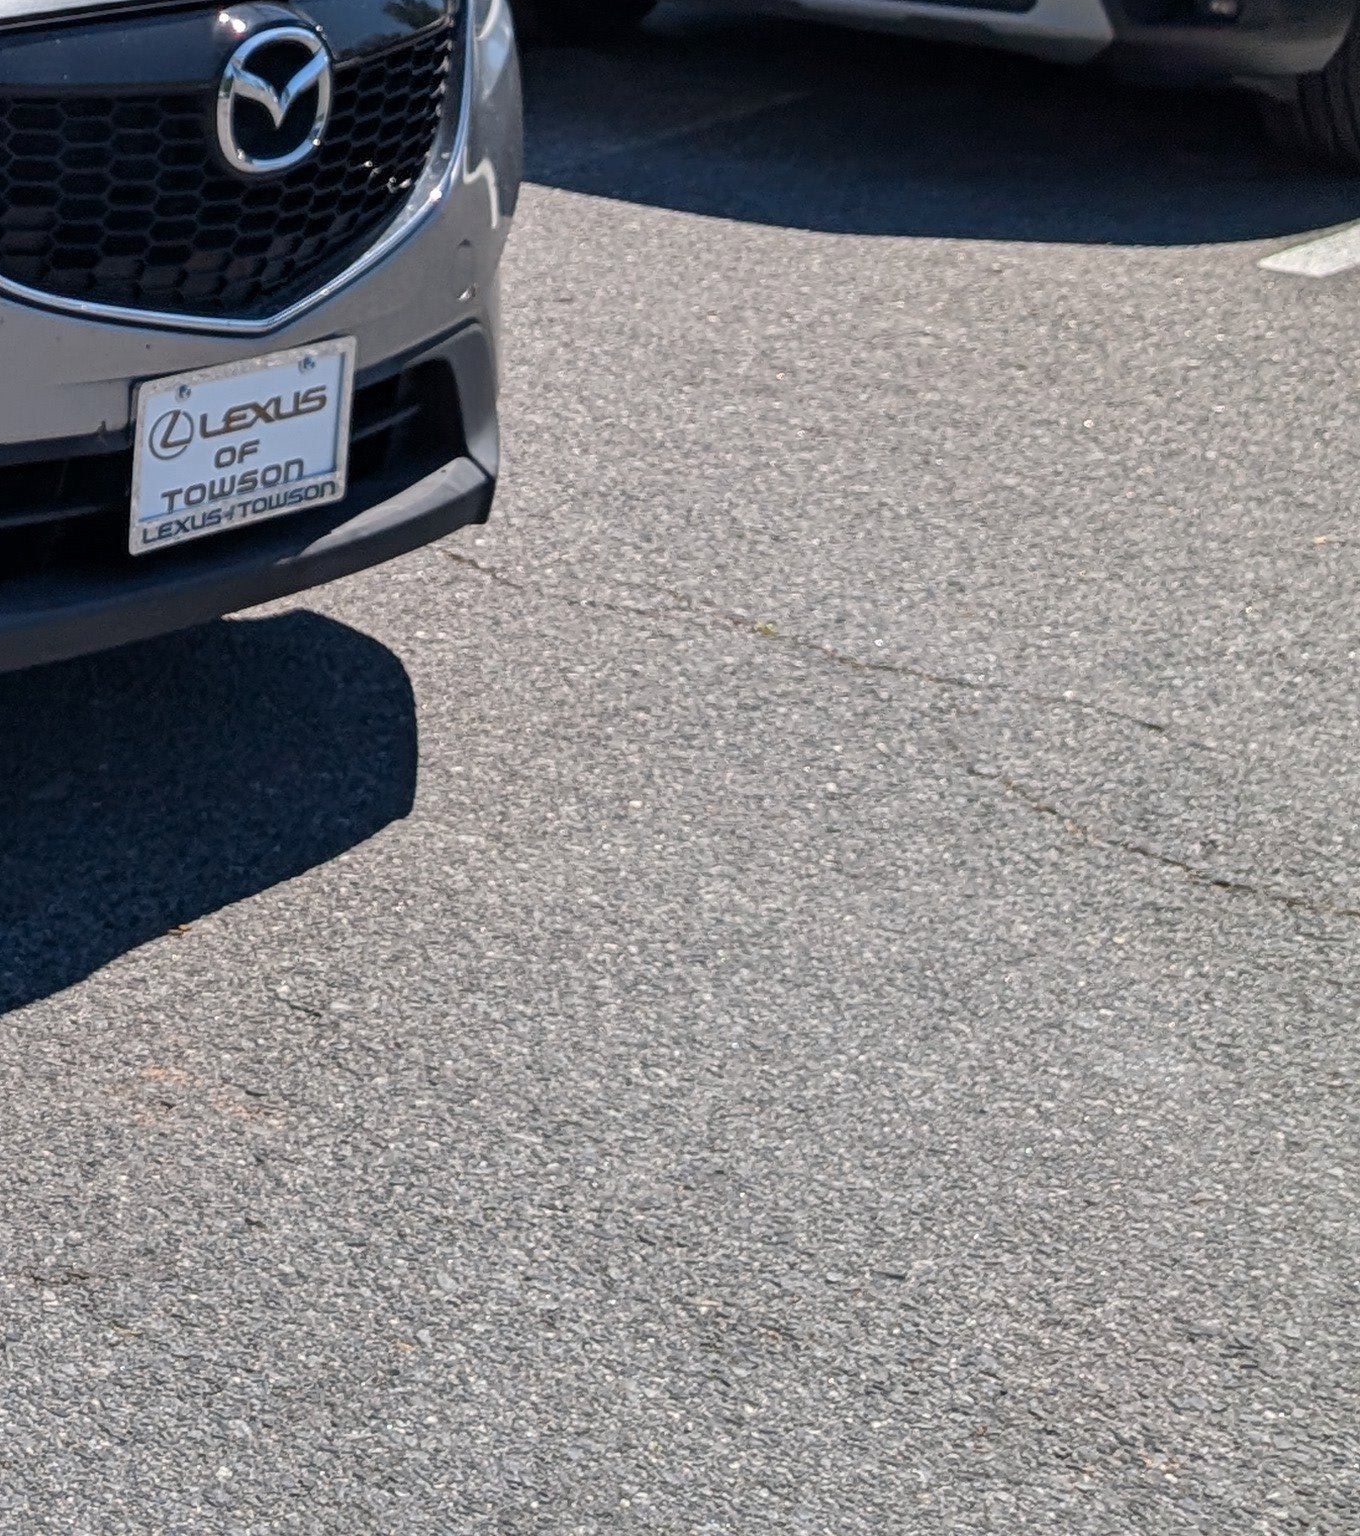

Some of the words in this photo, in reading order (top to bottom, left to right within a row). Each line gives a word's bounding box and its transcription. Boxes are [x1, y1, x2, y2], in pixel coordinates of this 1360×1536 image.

[200, 385, 328, 438] LEXUS
[214, 439, 260, 469] OF
[161, 459, 305, 513] TOWSON
